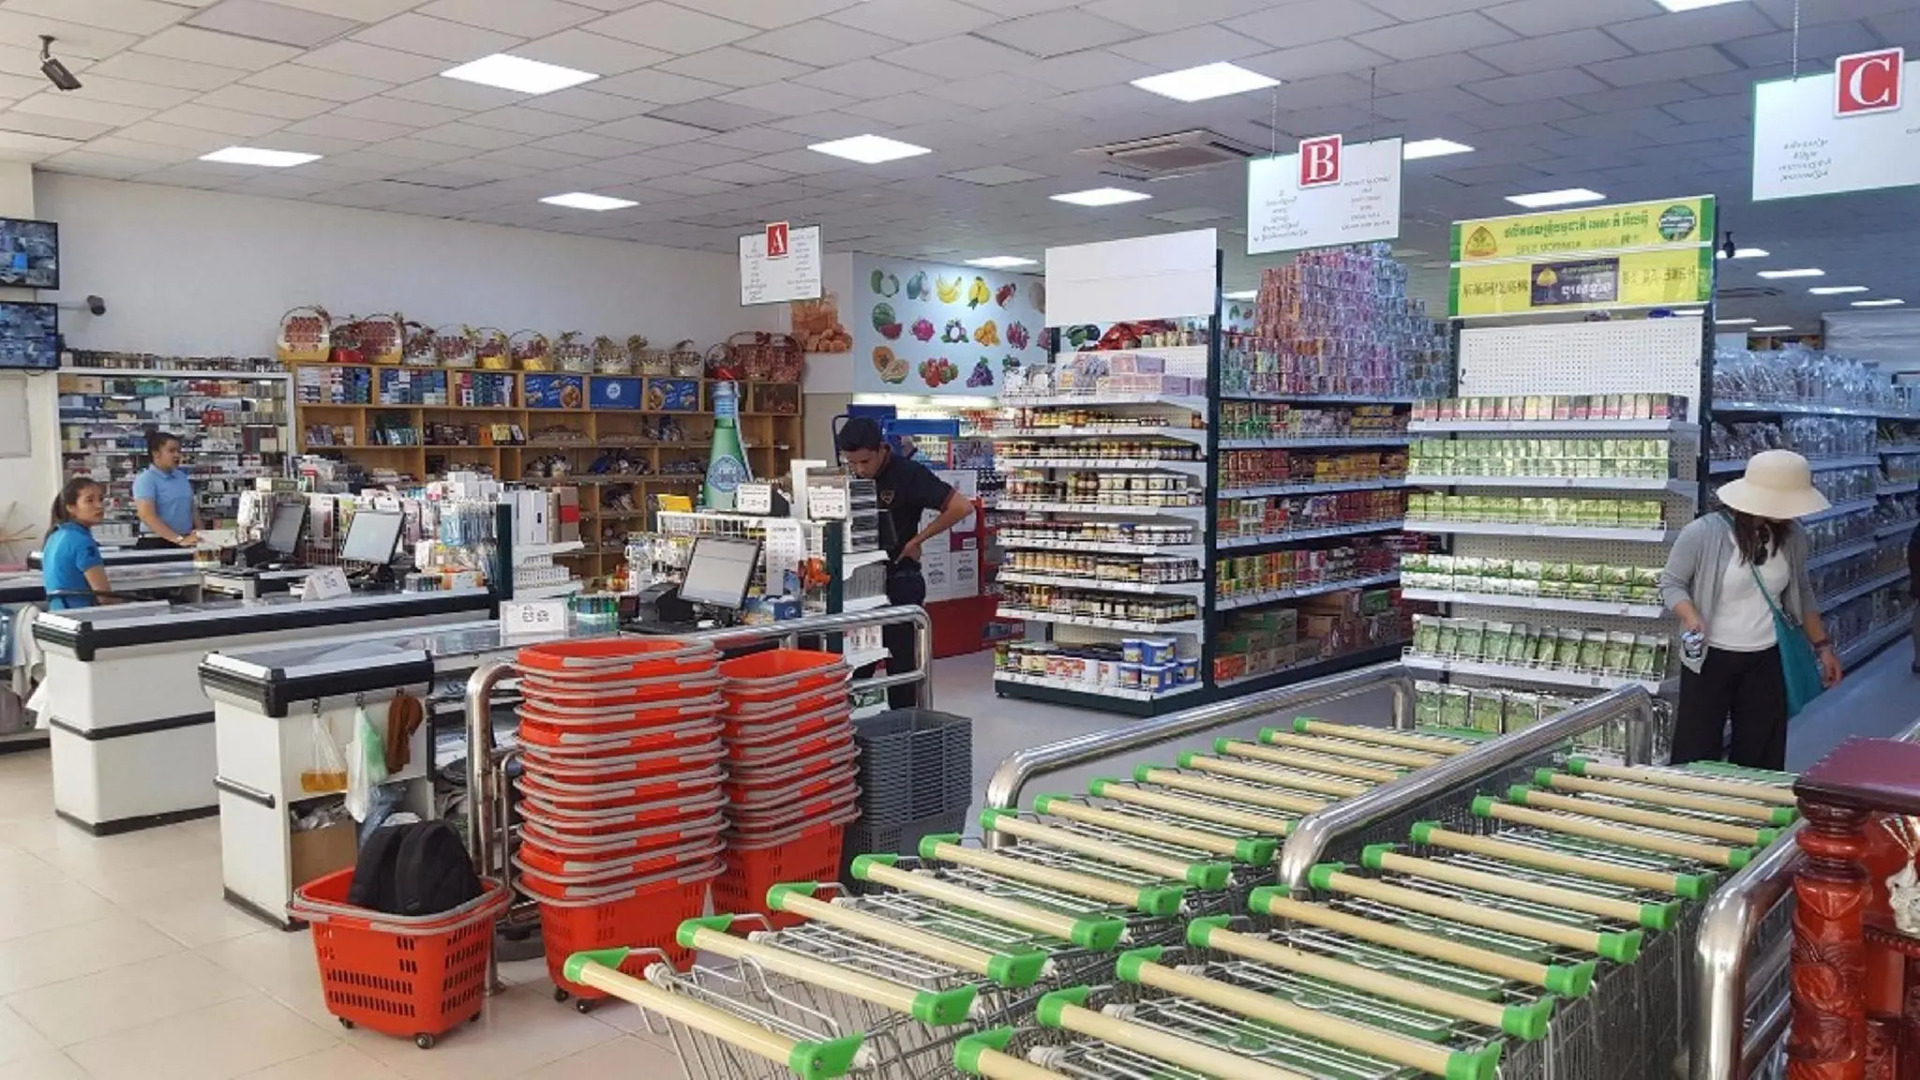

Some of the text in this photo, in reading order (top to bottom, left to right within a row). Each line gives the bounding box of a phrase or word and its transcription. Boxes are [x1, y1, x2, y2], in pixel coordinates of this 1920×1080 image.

[1850, 57, 1890, 105] C
[1307, 143, 1335, 181] B
[770, 227, 786, 254] A
